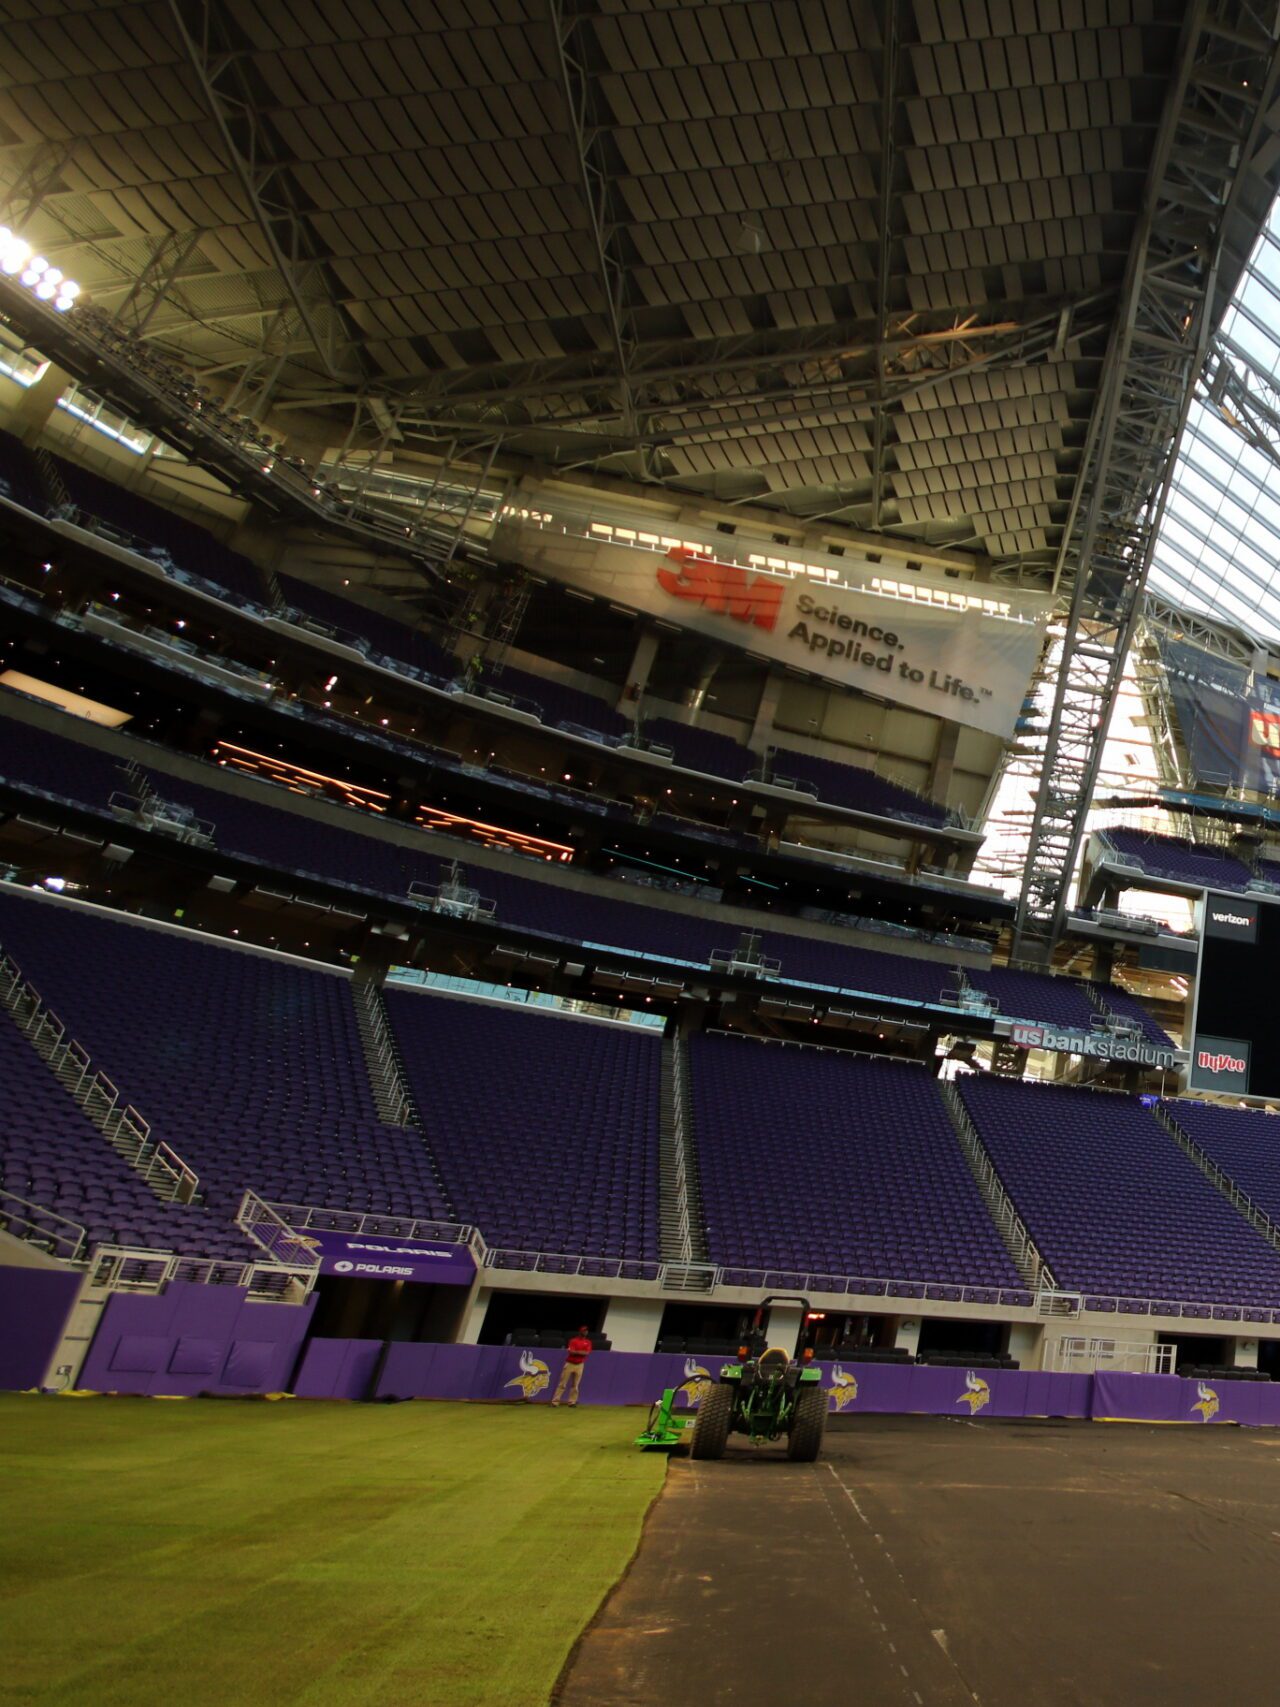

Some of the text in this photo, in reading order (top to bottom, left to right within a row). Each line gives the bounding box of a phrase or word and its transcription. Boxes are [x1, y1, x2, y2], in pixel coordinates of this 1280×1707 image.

[656, 546, 785, 633] 3M
[796, 593, 904, 652] Science.
[787, 620, 894, 674] Applied
[898, 660, 925, 685] to
[1212, 912, 1250, 926] verizon
[346, 1242, 454, 1258] POLARIS
[355, 1263, 415, 1276] POLARIS
